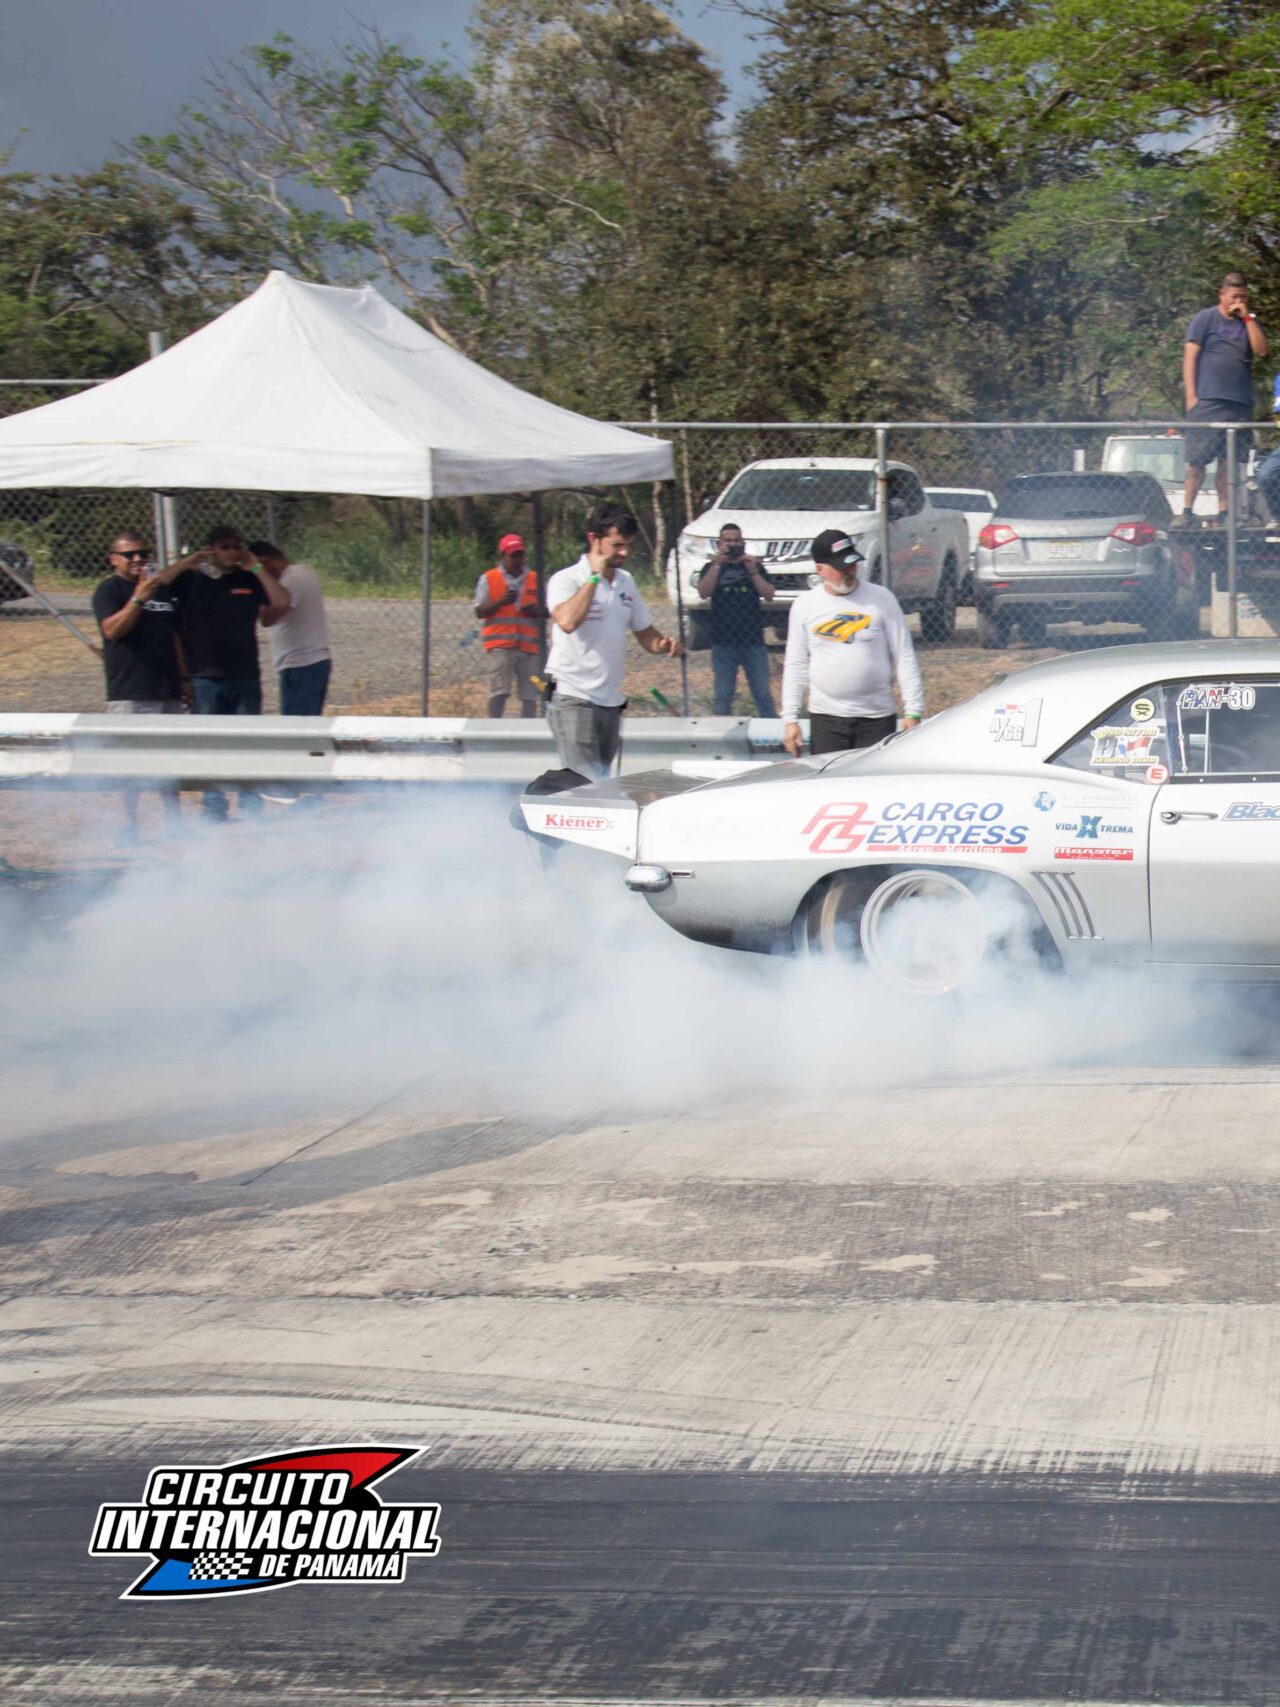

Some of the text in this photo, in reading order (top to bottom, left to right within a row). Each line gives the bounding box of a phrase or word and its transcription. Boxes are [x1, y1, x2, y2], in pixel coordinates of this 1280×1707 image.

[1181, 687, 1255, 710] PAN-30
[545, 814, 605, 829] Kiener
[881, 802, 1004, 822] CARGO
[866, 825, 1029, 844] EXPRESS
